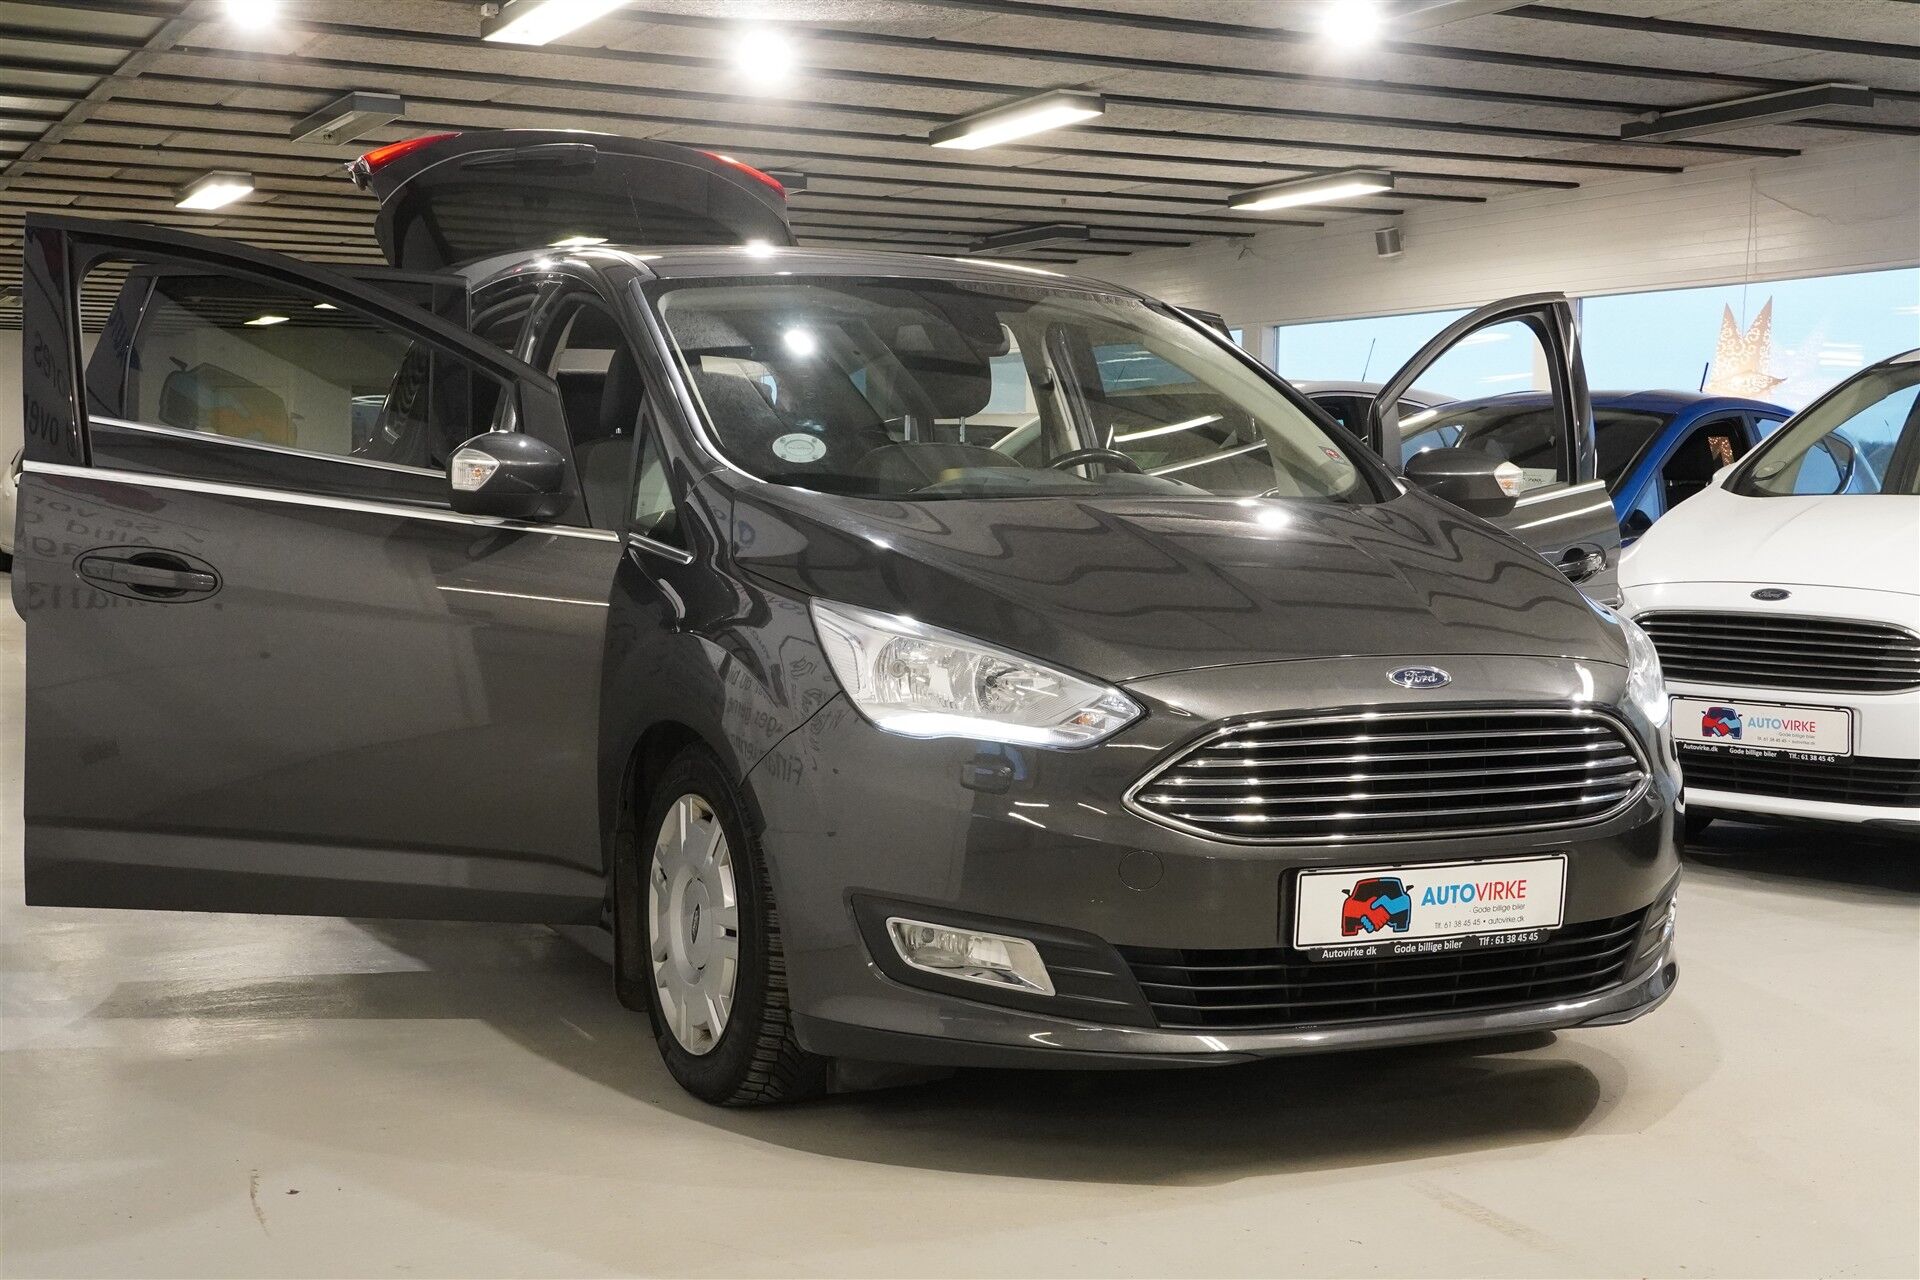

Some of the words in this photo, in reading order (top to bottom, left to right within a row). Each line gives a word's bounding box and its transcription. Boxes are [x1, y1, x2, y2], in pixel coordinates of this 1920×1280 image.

[1404, 670, 1438, 683] Ford
[1748, 717, 1816, 732] AUTOVIRKE
[1683, 743, 1718, 752] Autovirke.dk
[1745, 748, 1762, 757] billige
[1421, 880, 1527, 906] AUTOVIRKE
[1472, 906, 1491, 914] Gode
[1492, 904, 1511, 913] billige
[1512, 903, 1526, 911] biler
[1444, 921, 1452, 929] 61
[1453, 920, 1462, 928] 38
[1495, 935, 1504, 944] 61
[1506, 935, 1516, 943] 38
[1518, 933, 1527, 942] 45
[1529, 932, 1539, 941] 45
[1394, 944, 1416, 954] Gode
[1418, 942, 1442, 953] billige
[1444, 940, 1463, 950] biler
